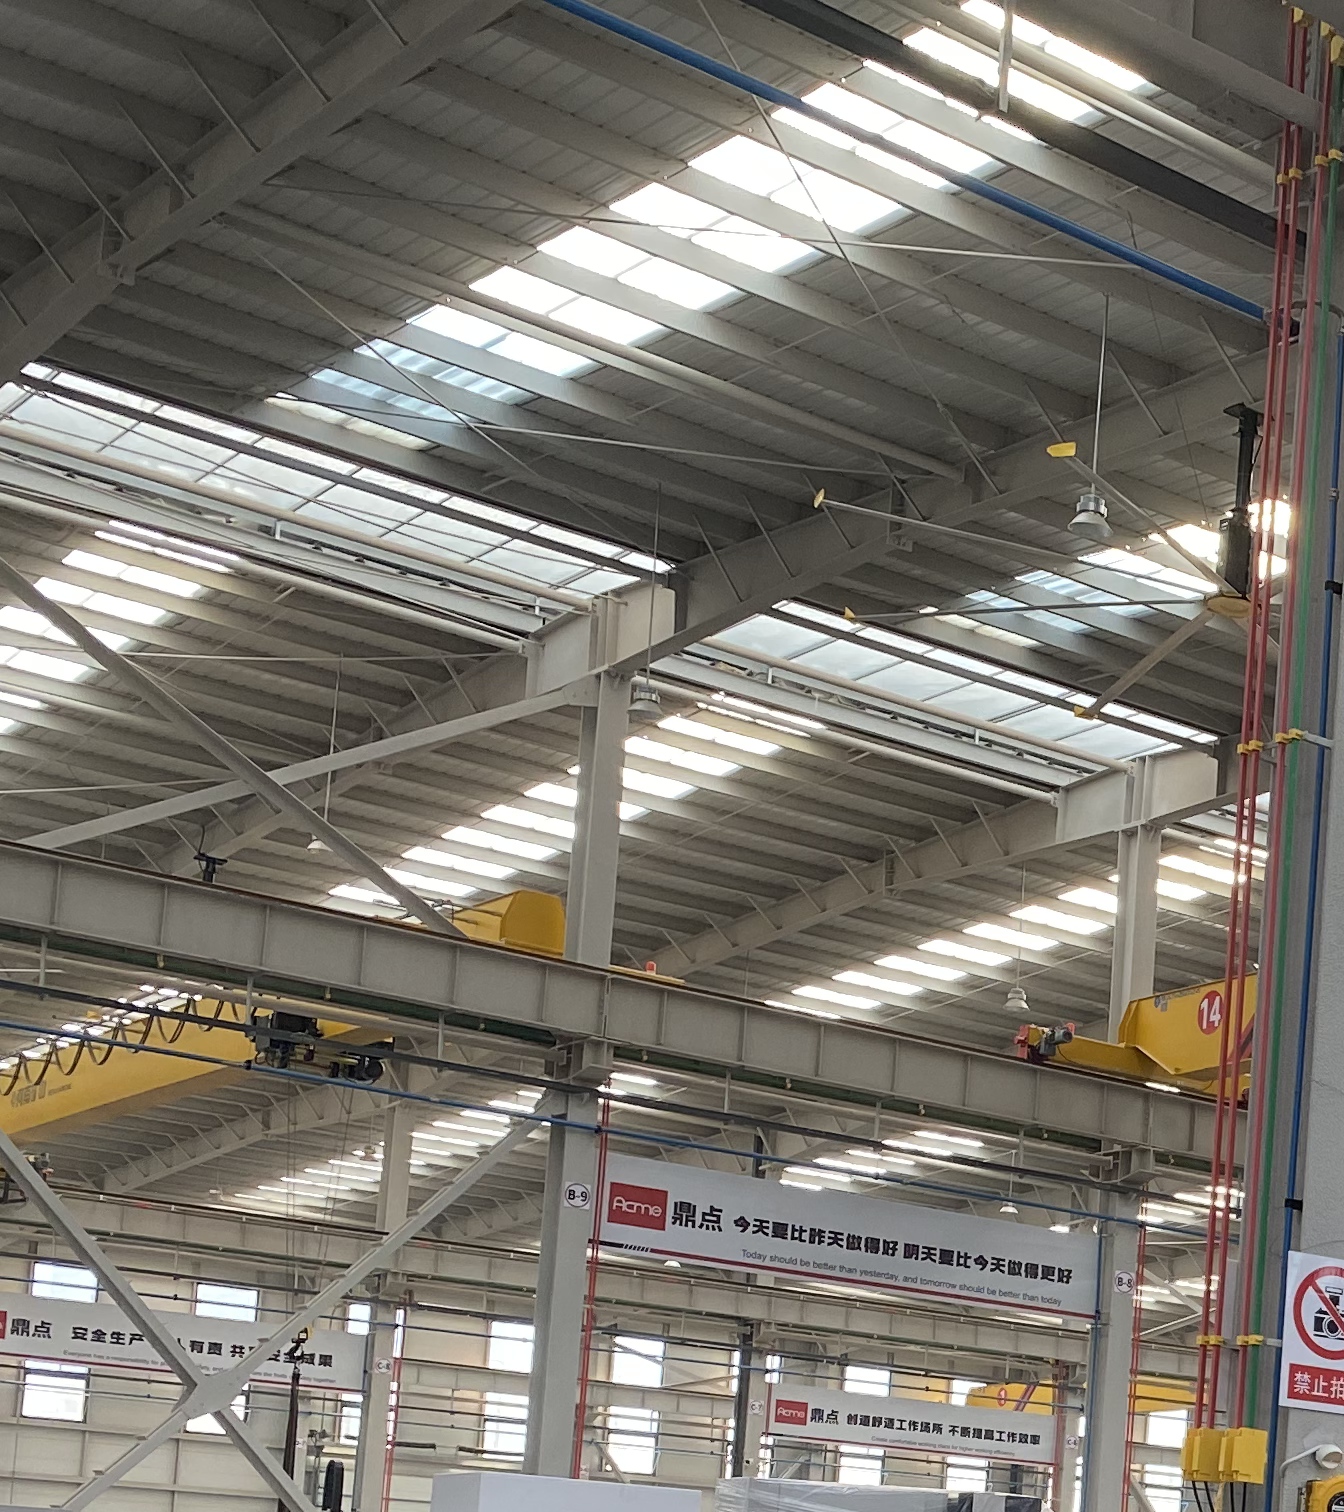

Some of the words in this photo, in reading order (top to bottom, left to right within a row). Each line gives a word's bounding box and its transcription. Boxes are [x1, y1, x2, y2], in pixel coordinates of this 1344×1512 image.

[1200, 994, 1221, 1030] 14
[567, 1188, 588, 1201] B-9
[612, 1196, 662, 1218] Acme
[671, 1200, 724, 1232] 鼎点
[733, 1215, 898, 1259] 今天要比昨天做得好
[903, 1243, 1073, 1285] 明天要比今天做得更好
[741, 1249, 768, 1263] Today
[769, 1254, 798, 1266] should
[800, 1258, 811, 1267] be
[812, 1261, 837, 1271] better
[838, 1264, 858, 1274] than
[859, 1268, 900, 1282] yesterday,
[902, 1274, 918, 1284] and
[919, 1277, 958, 1289] tomorrow
[958, 1283, 985, 1294] should
[986, 1286, 997, 1296] be
[998, 1288, 1021, 1299] better
[1022, 1292, 1040, 1302] than
[1040, 1295, 1062, 1307] today
[10, 1318, 52, 1339] 鼎点
[71, 1326, 145, 1346] 安全生产
[810, 1408, 839, 1425] 鼎点
